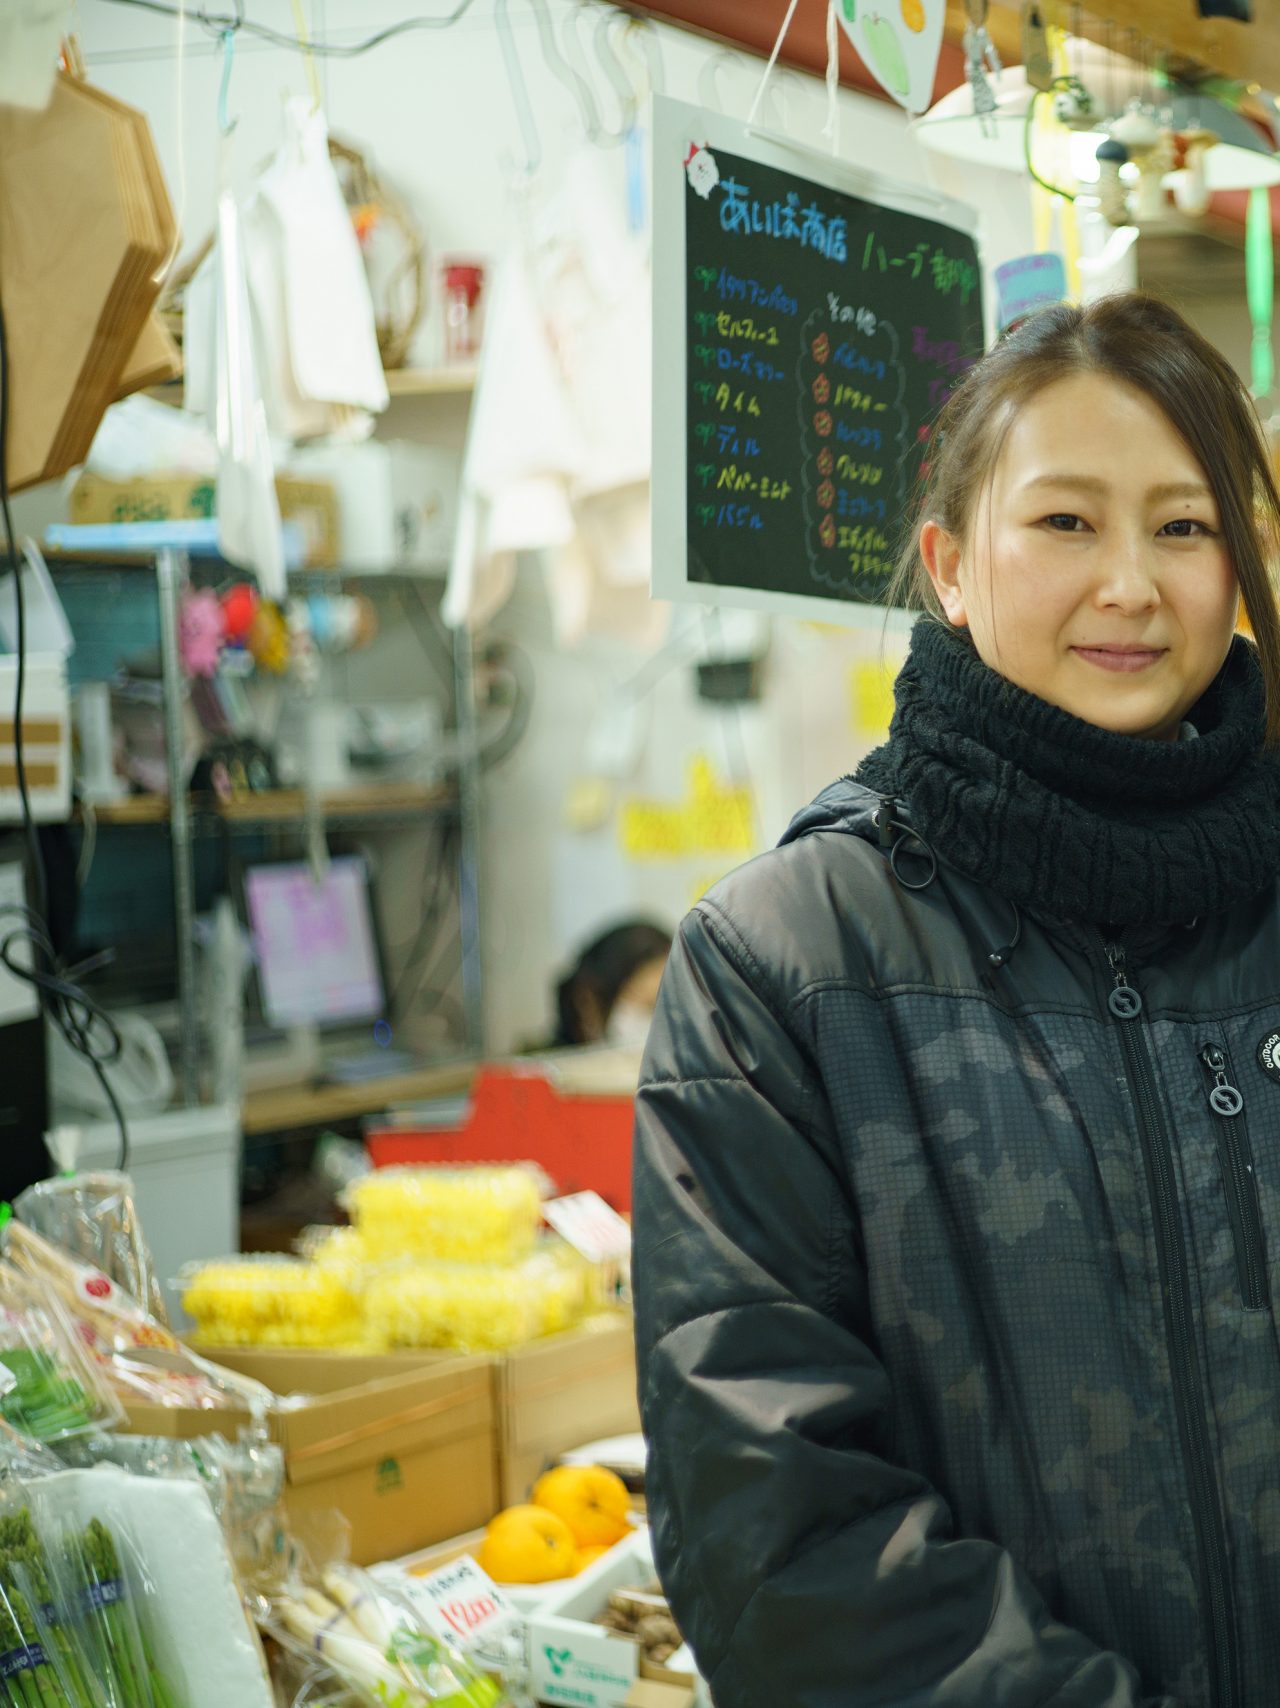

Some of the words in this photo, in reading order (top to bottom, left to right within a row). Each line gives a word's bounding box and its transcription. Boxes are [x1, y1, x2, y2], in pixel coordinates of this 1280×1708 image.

[716, 382, 761, 418] タイム
[717, 424, 761, 457] ディル
[1262, 1033, 1280, 1069] OUTDOOR
